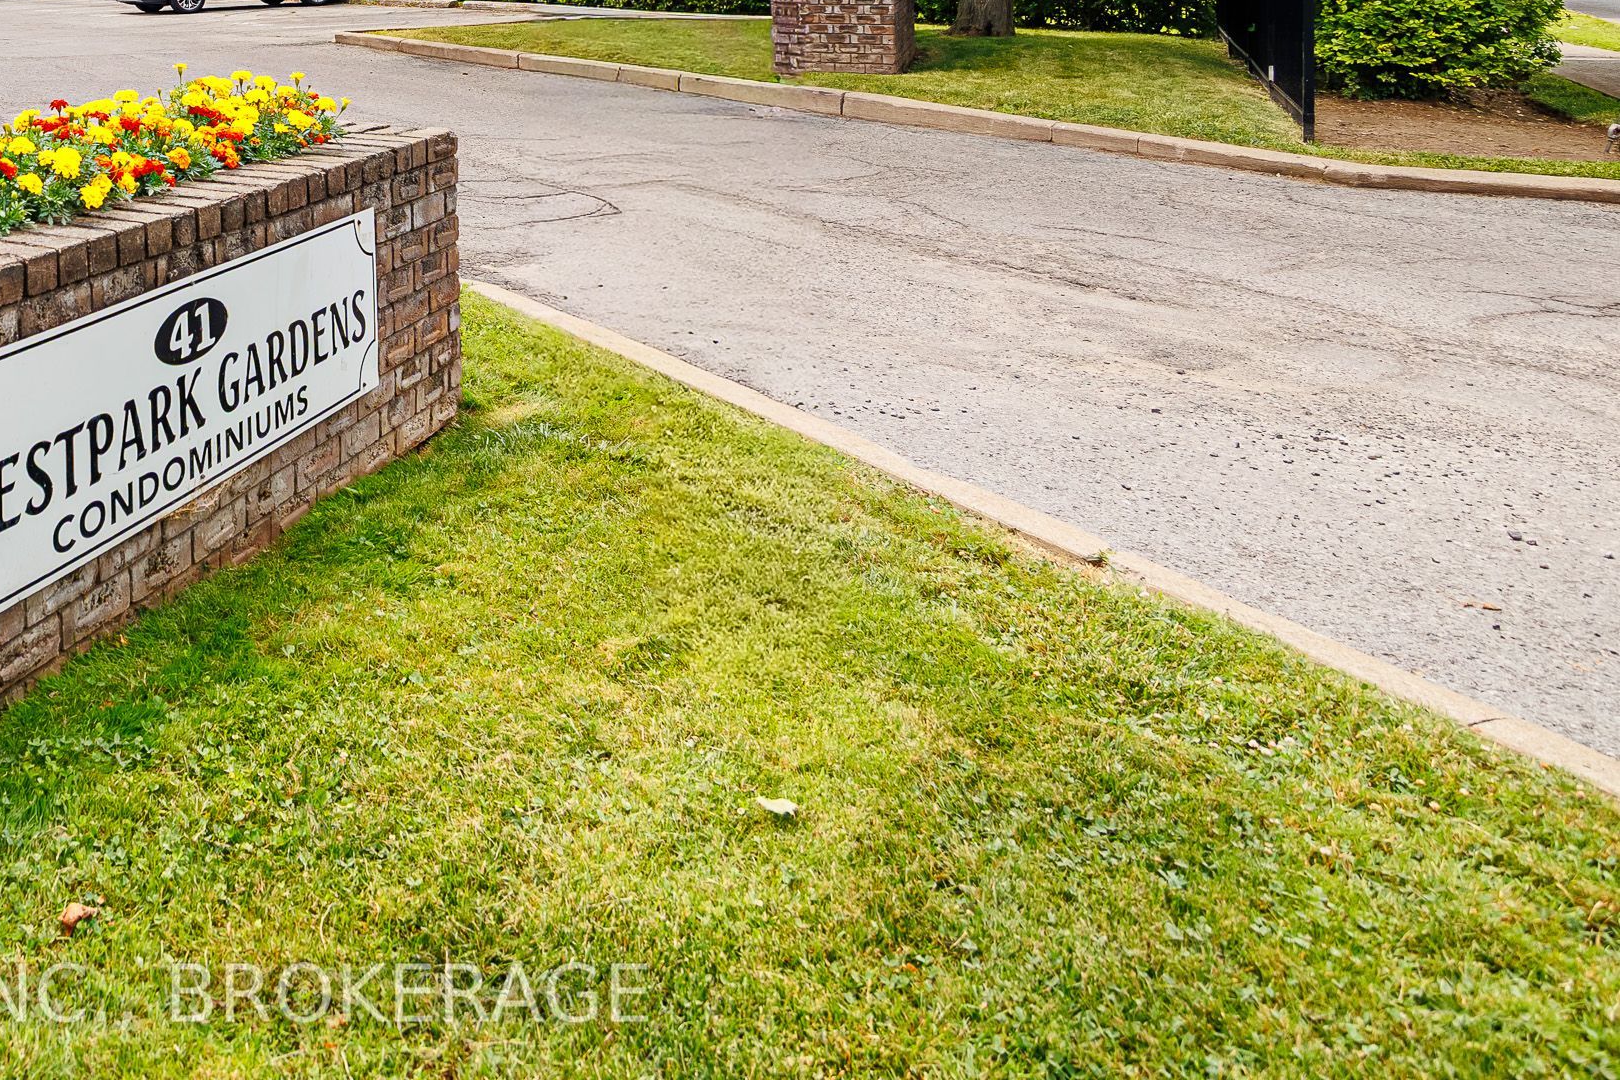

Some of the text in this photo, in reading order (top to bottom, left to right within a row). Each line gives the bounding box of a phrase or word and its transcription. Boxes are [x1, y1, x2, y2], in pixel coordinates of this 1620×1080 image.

[168, 301, 217, 360] 41
[218, 288, 367, 414] GARDENS
[52, 384, 309, 554] CONDOMINIUMS
